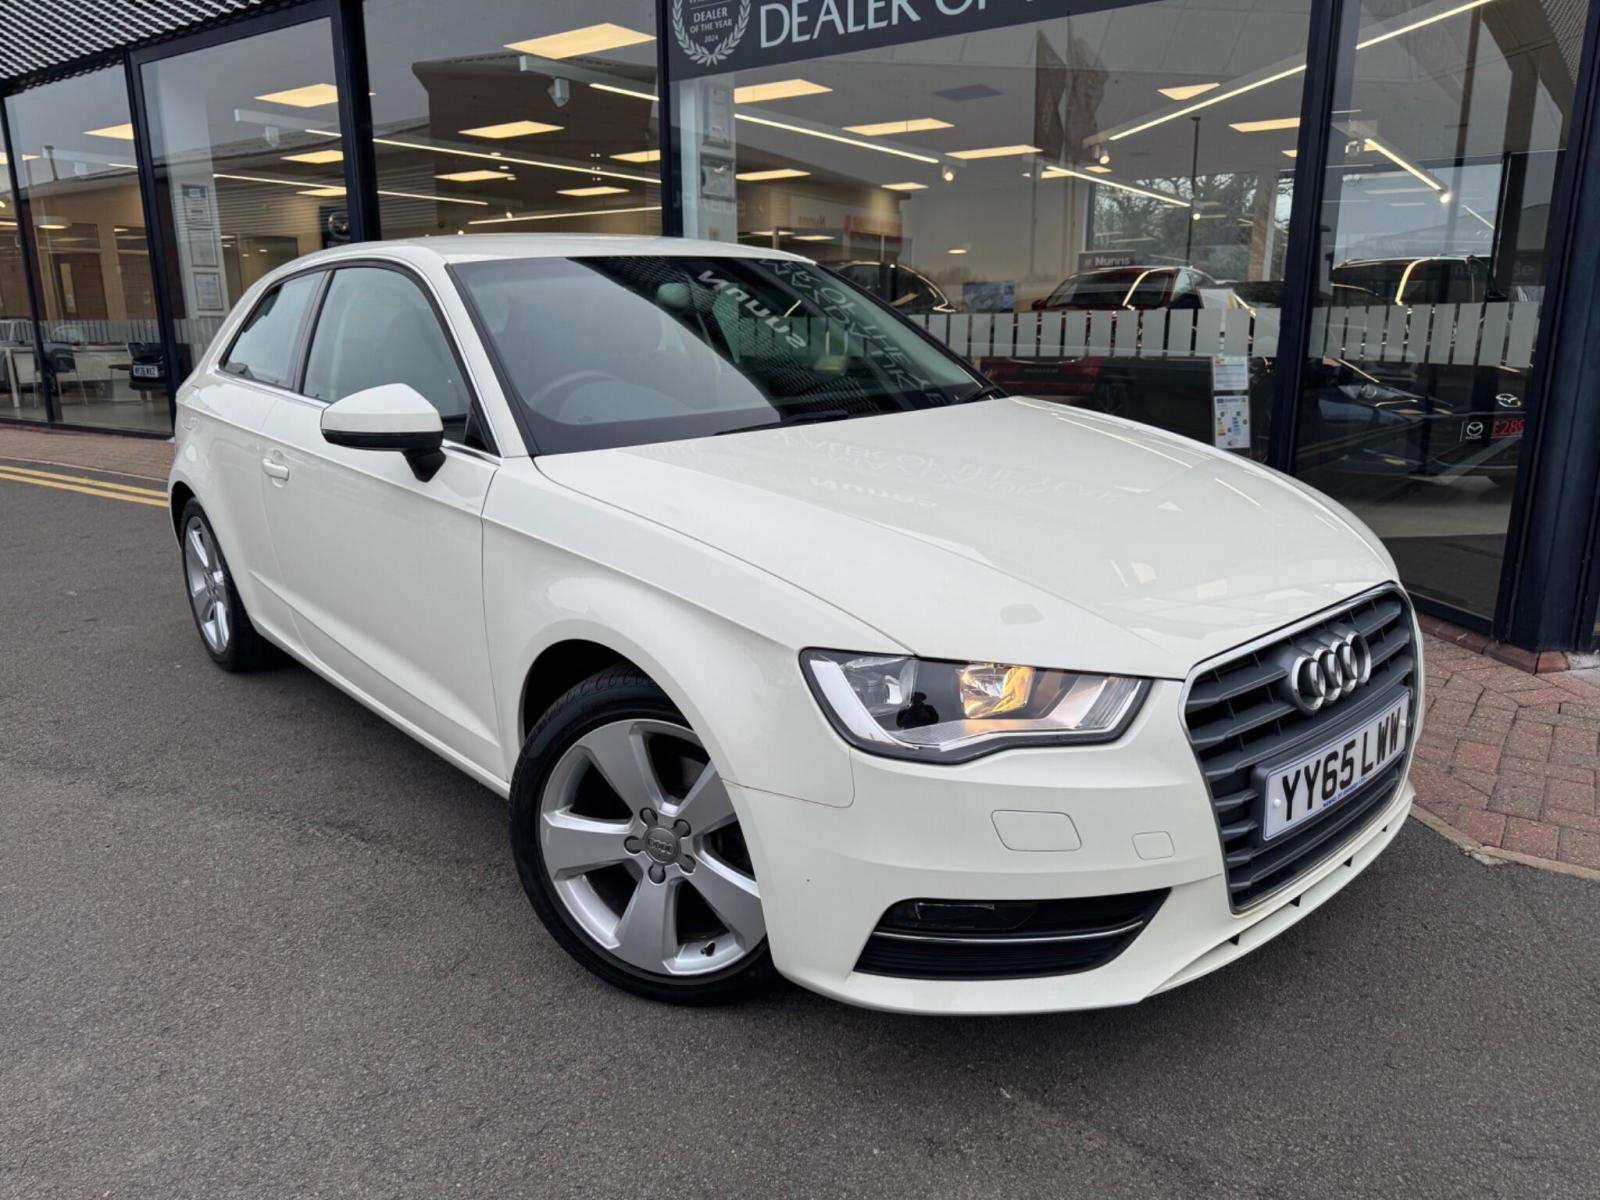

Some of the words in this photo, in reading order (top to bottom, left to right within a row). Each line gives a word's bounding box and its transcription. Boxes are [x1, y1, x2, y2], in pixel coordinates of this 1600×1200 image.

[693, 7, 728, 23] DEALER
[690, 25, 699, 34] OF
[701, 21, 714, 32] THE
[715, 18, 733, 29] YEAR
[1282, 739, 1357, 821] YY65
[1360, 707, 1402, 777] LWW
